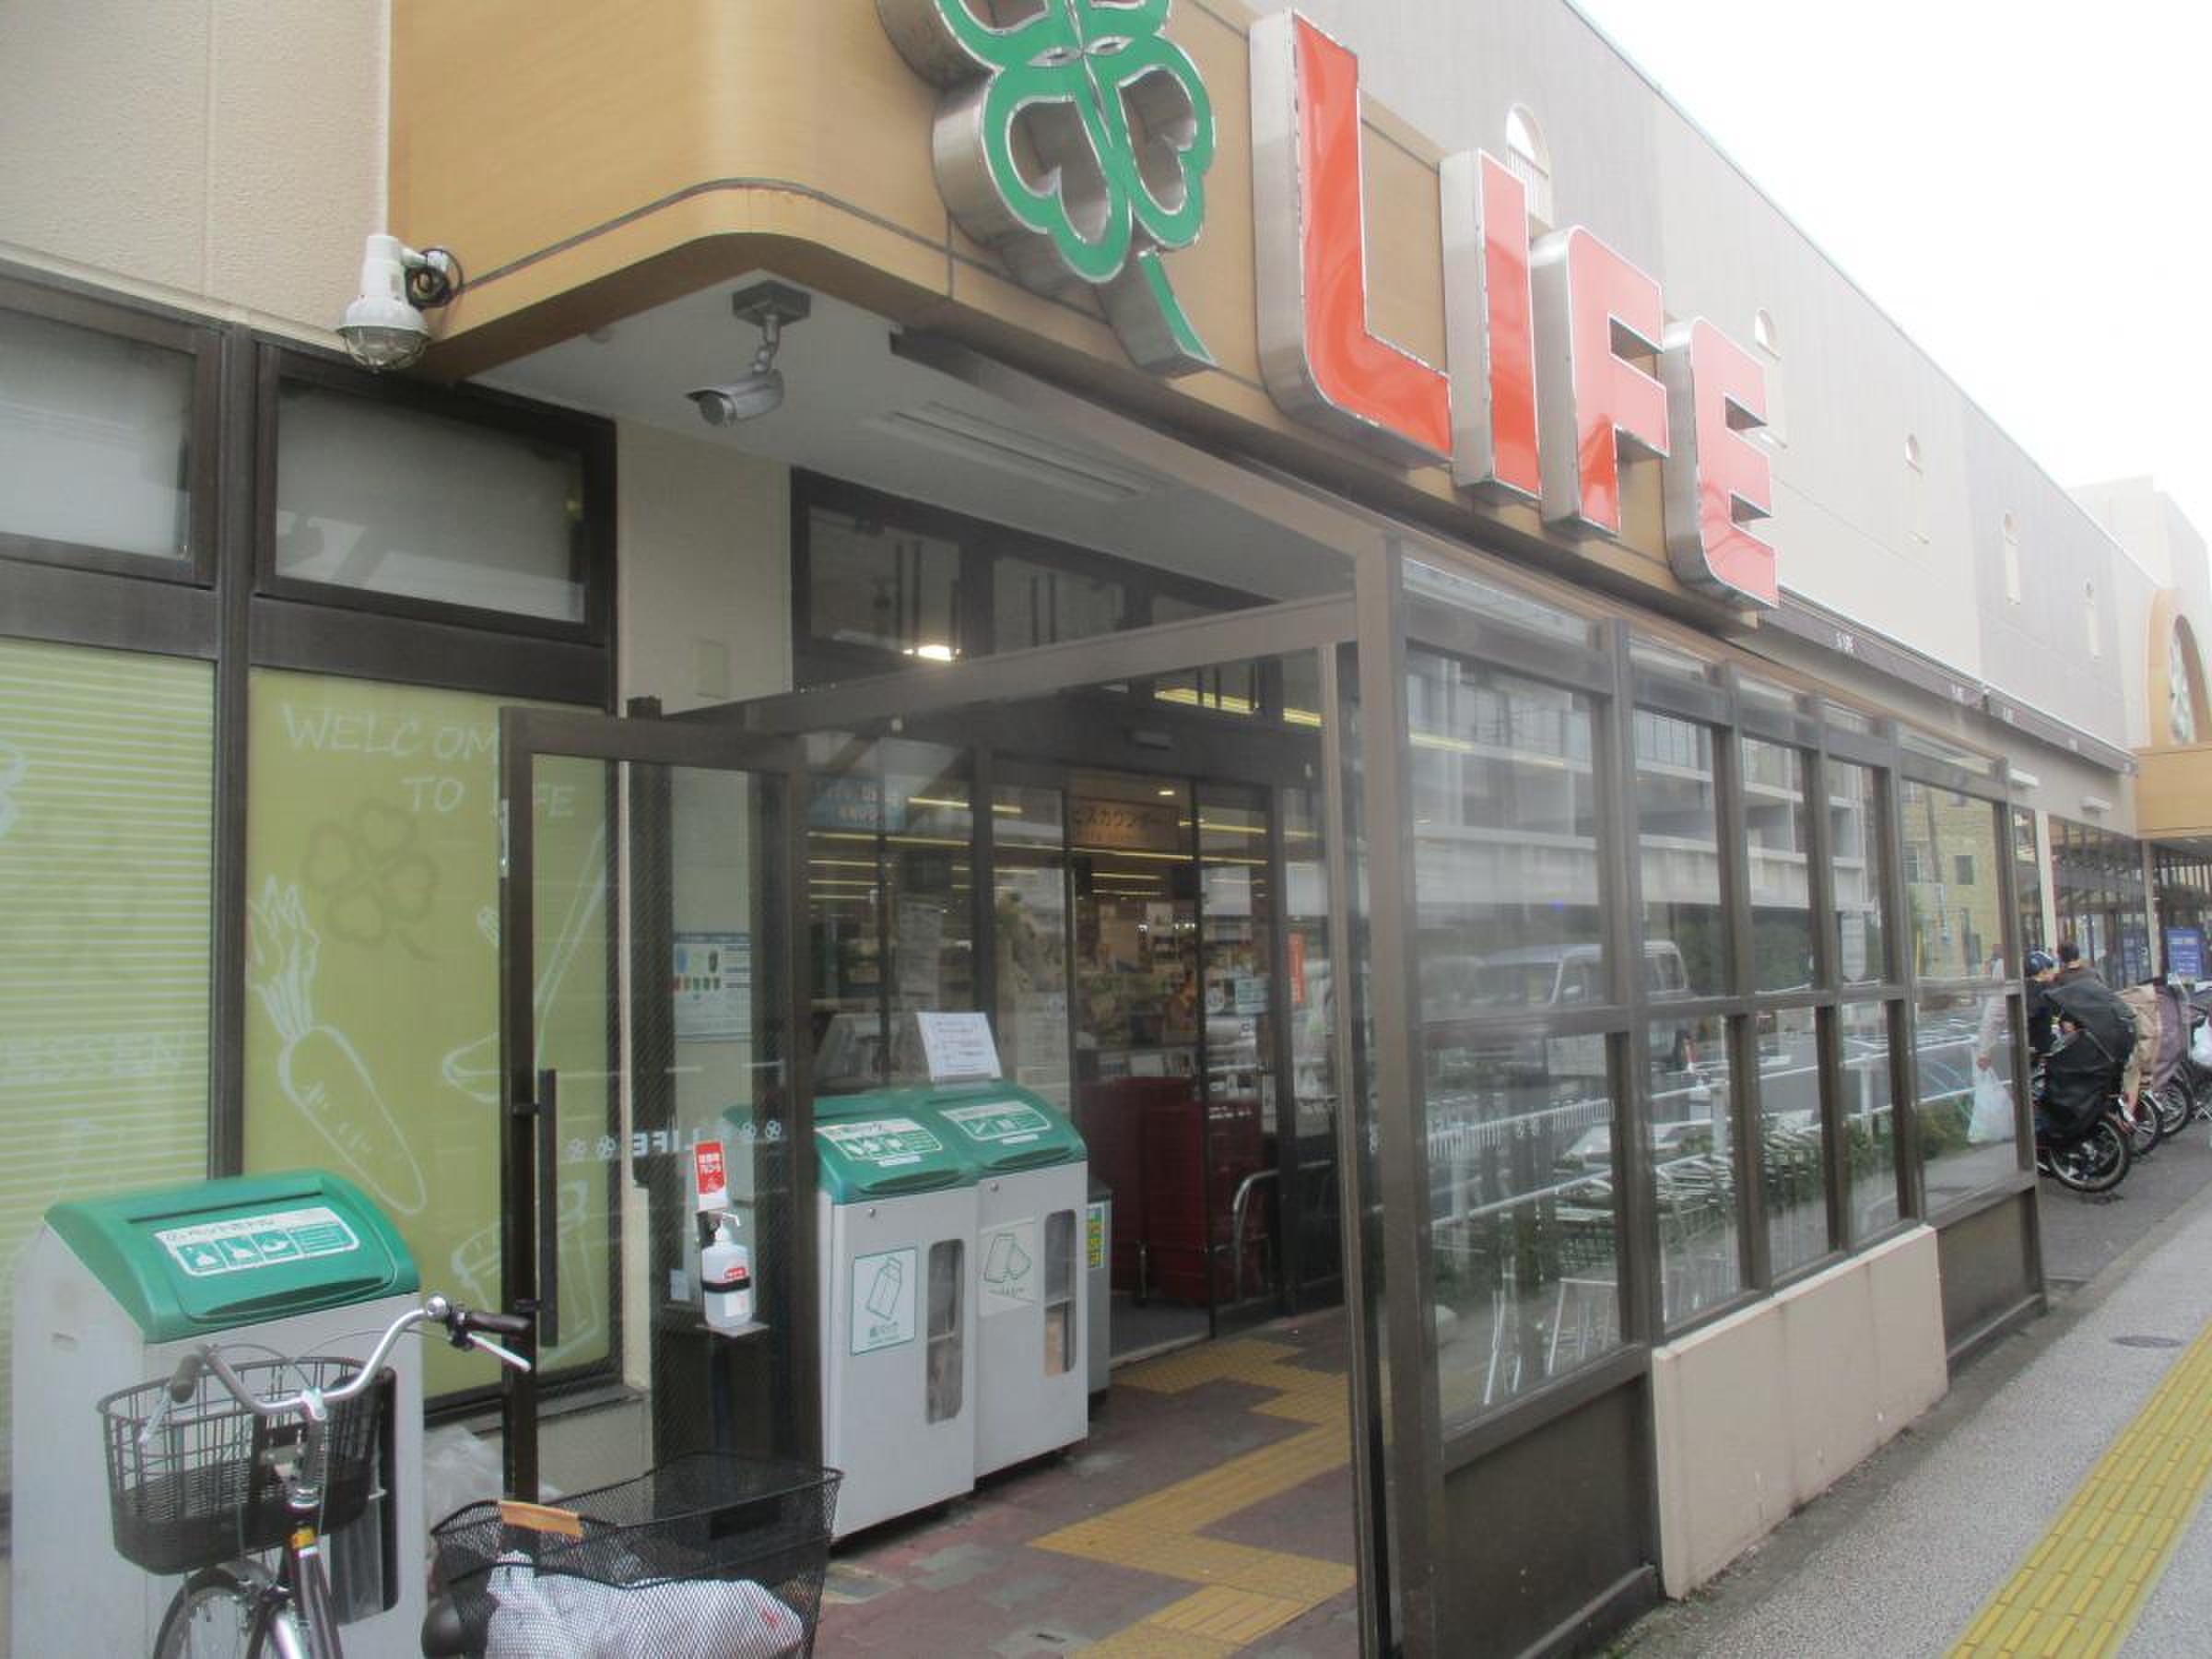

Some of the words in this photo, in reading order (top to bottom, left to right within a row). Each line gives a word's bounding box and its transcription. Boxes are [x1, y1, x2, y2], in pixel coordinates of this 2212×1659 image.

[1250, 9, 1781, 608] LIFE
[281, 700, 500, 761] WELCOM
[399, 776, 464, 813] TO
